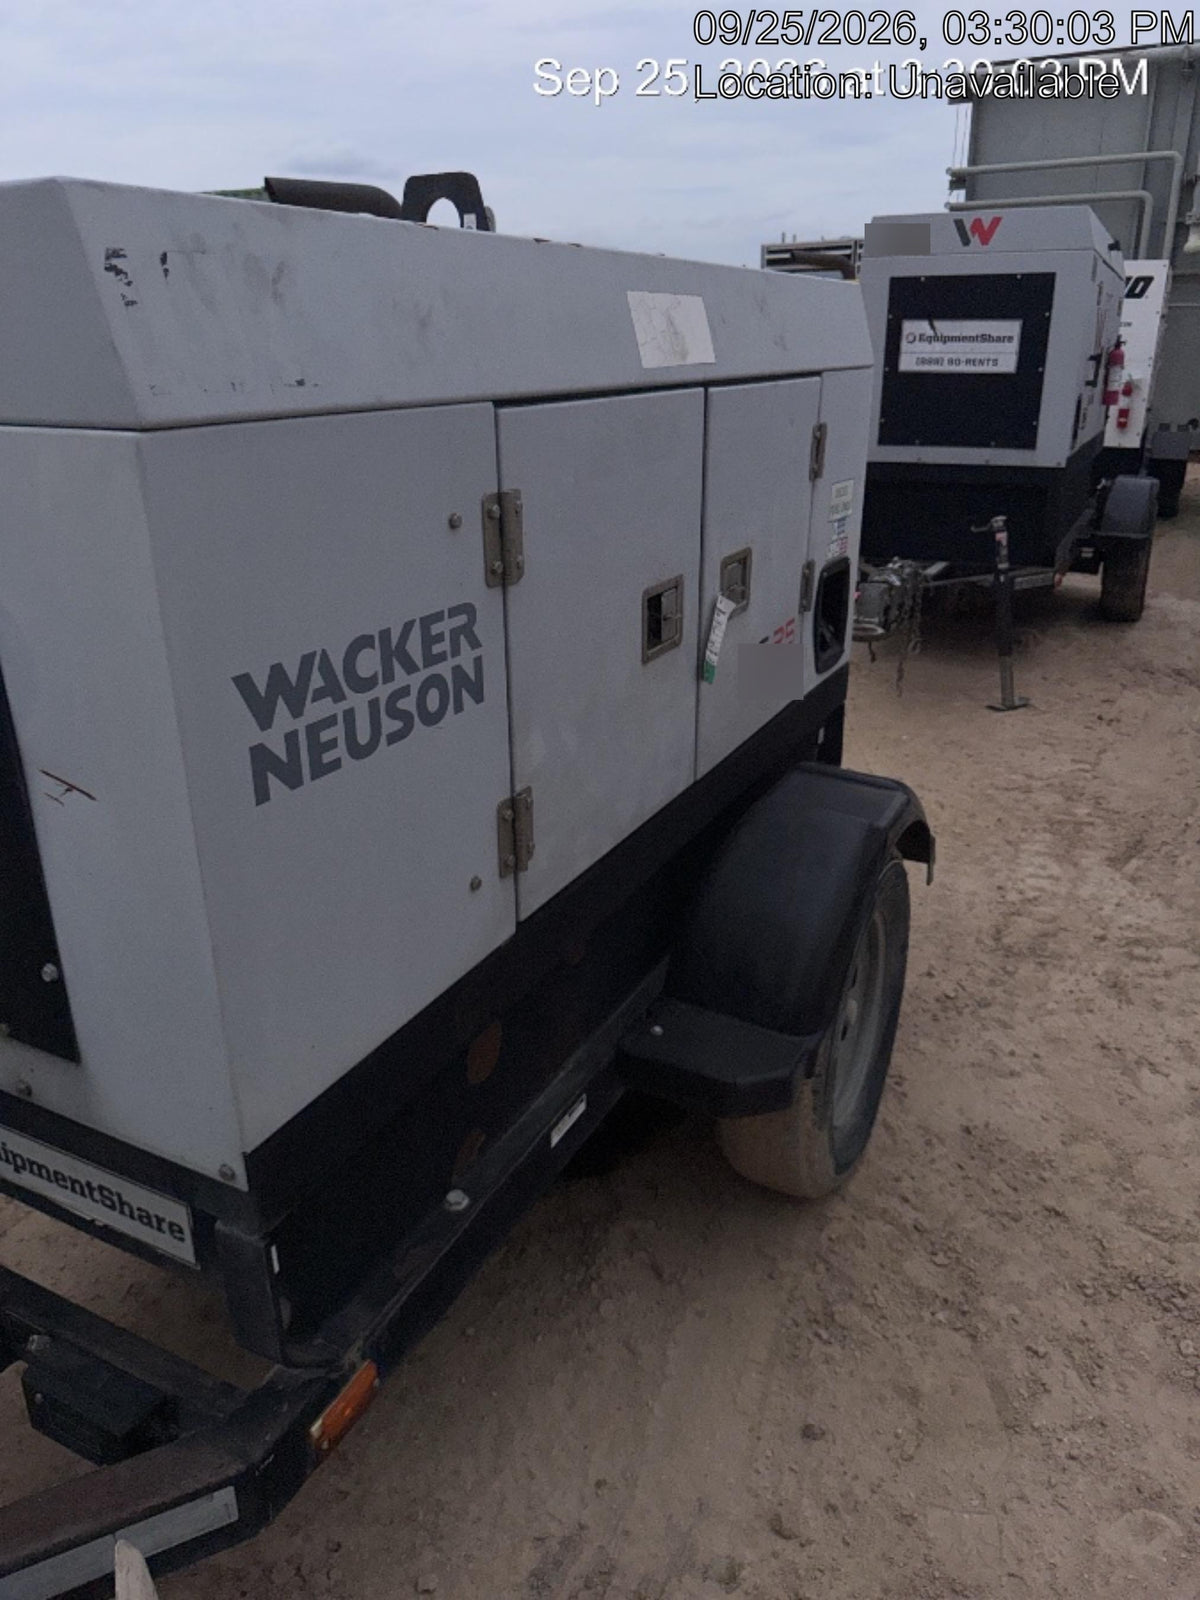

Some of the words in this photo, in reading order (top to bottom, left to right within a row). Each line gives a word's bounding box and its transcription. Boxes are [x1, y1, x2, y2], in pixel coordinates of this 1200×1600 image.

[918, 332, 1014, 345] EquipmentShare
[231, 602, 483, 732] WACKER
[248, 654, 485, 807] NEUSON
[0, 1141, 186, 1243] ipmentShare
